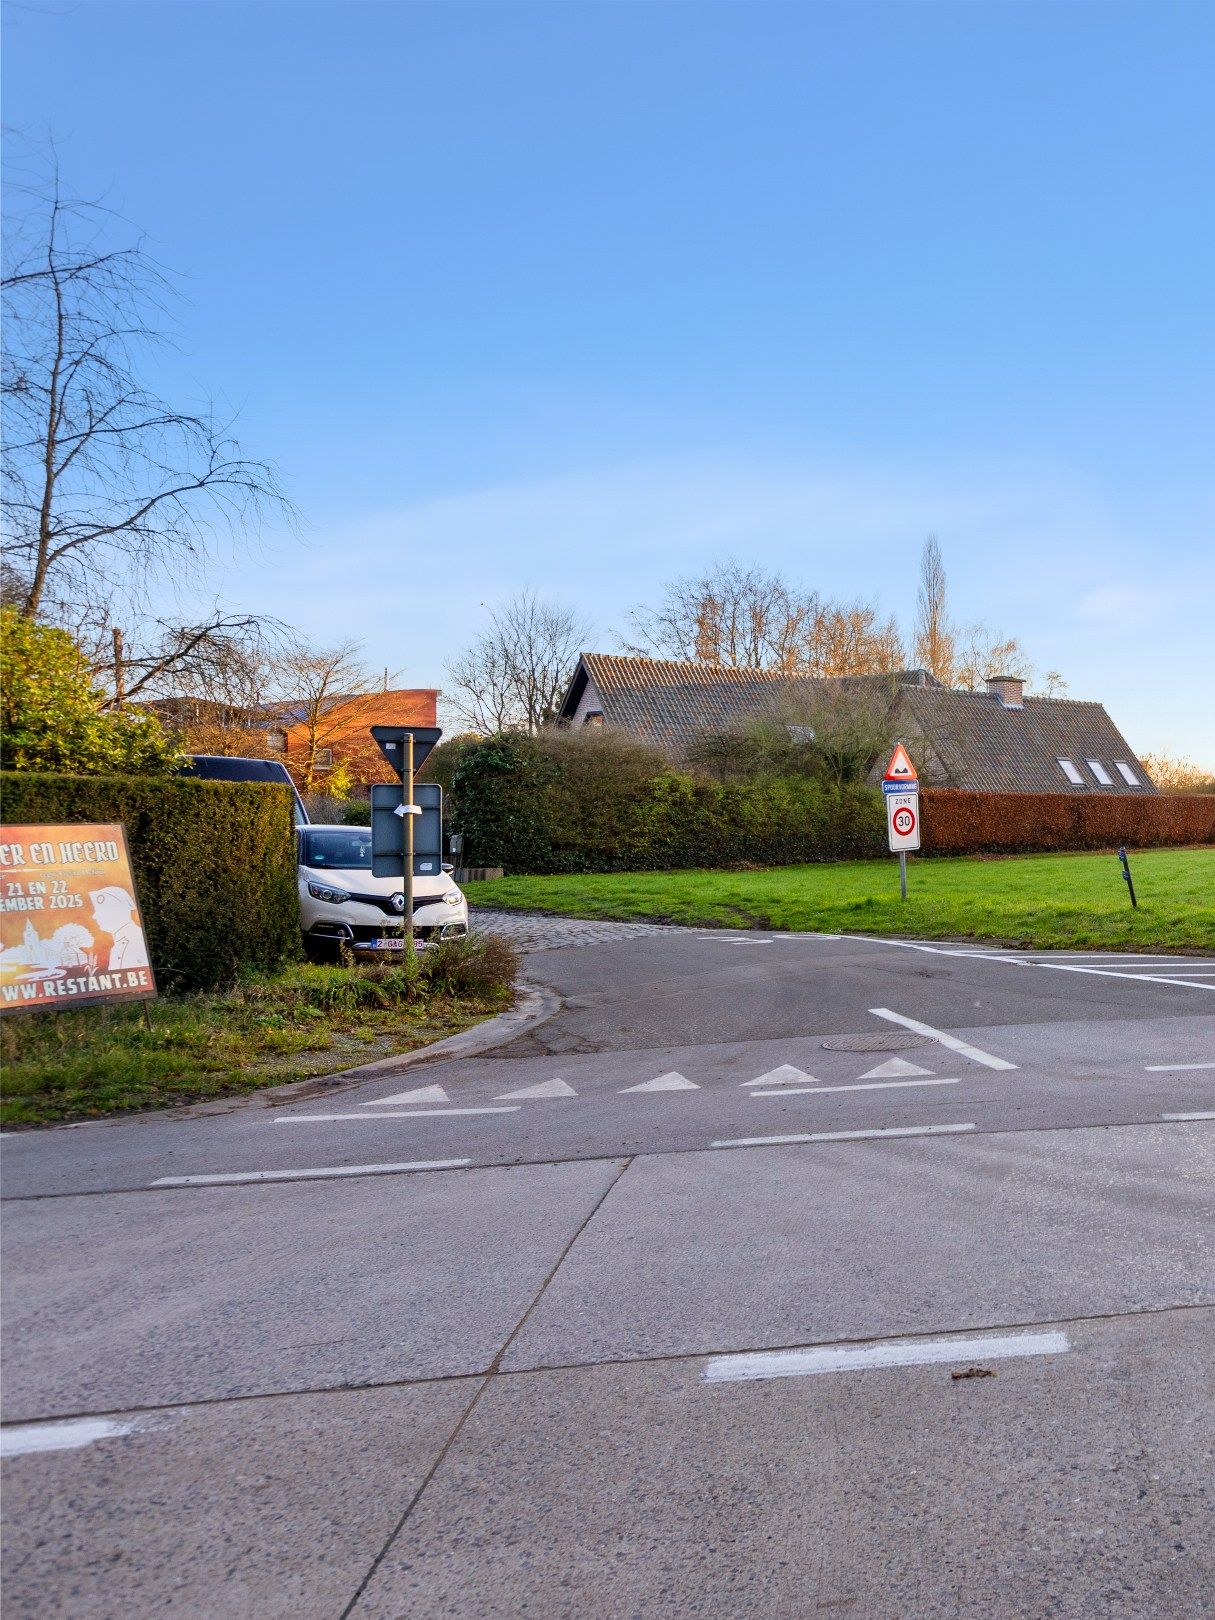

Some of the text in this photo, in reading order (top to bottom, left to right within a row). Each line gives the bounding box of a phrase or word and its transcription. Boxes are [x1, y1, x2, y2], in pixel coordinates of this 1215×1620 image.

[895, 797, 911, 805] ZONE
[898, 815, 911, 827] 30
[30, 842, 56, 865] EN
[6, 880, 68, 897] 21 EN 22
[49, 894, 84, 909] 2025
[2, 971, 149, 1001] WW.RESTANT.BE
